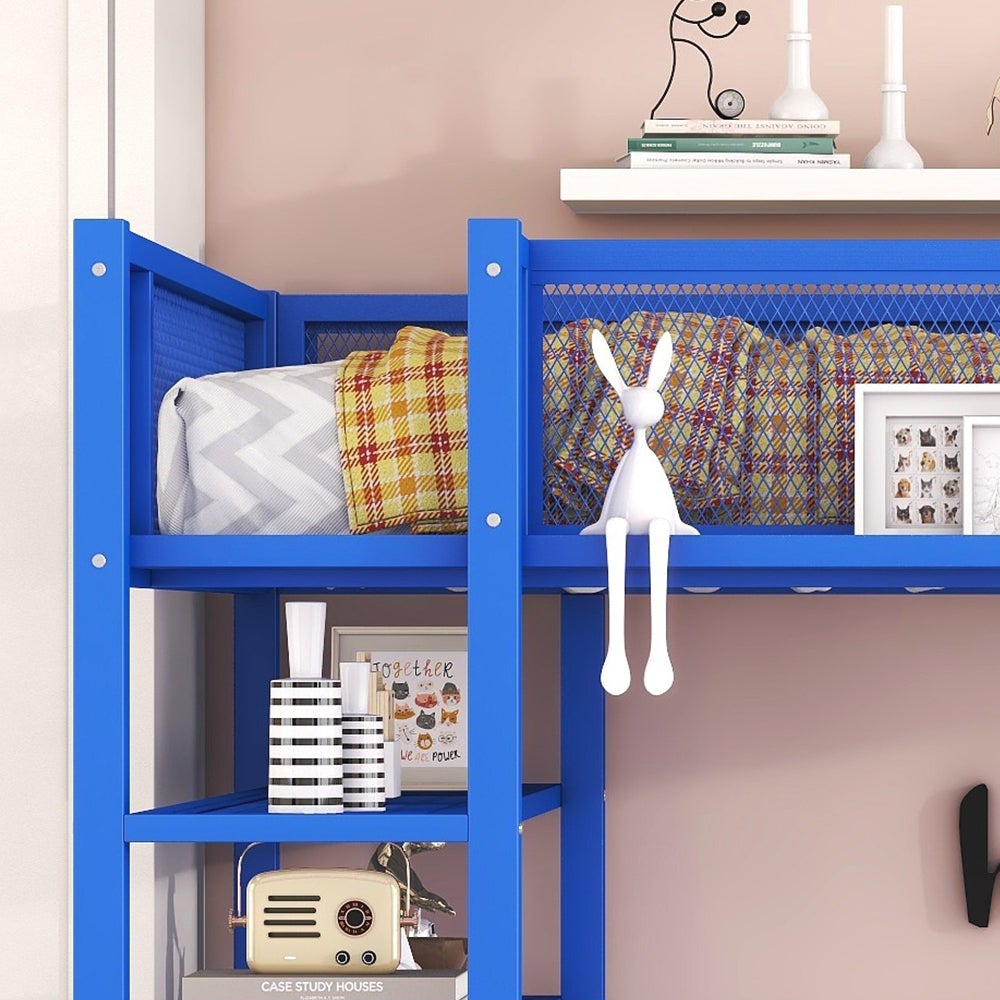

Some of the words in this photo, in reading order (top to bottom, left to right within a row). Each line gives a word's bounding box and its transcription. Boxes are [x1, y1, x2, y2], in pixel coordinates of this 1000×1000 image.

[261, 981, 293, 993] CASE
[295, 981, 334, 993] STUDY
[336, 981, 384, 993] HOUSES
